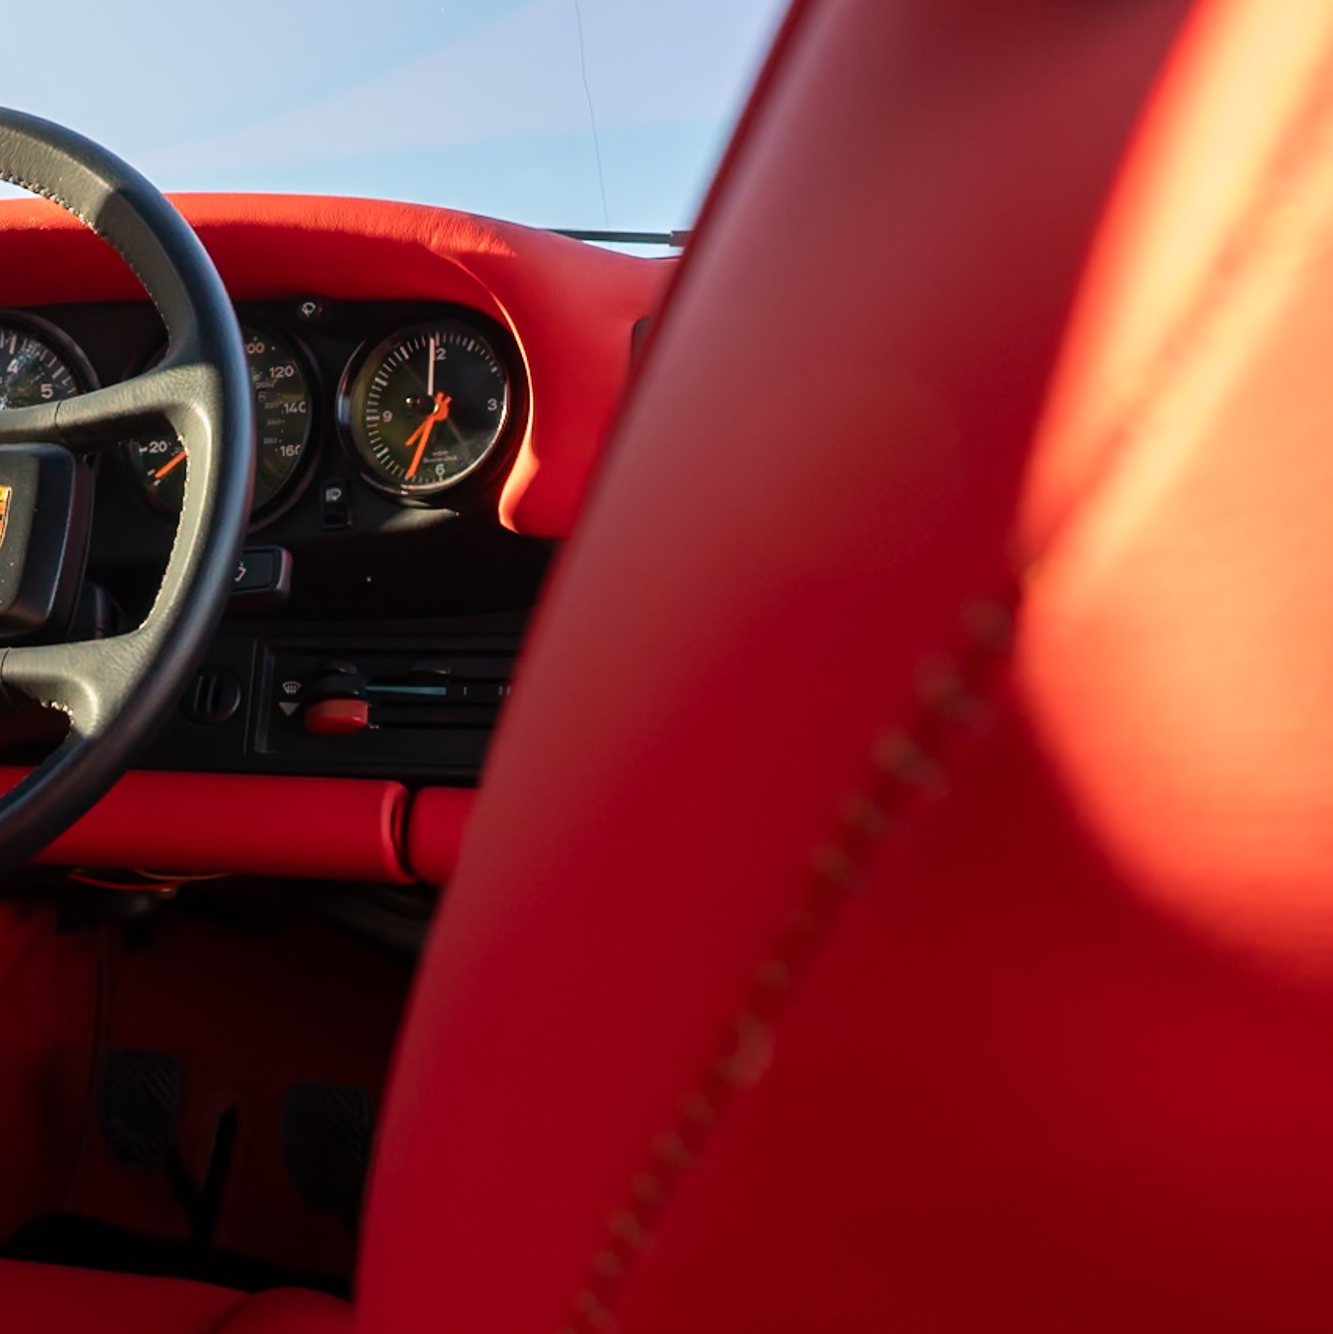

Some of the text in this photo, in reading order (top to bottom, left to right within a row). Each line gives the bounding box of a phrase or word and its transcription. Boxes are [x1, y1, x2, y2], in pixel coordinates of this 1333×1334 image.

[245, 342, 265, 354] 00
[435, 348, 446, 360] 2
[7, 359, 19, 374] 4
[268, 365, 295, 379] 120
[40, 383, 54, 399] 5
[283, 402, 306, 413] 140
[487, 398, 498, 411] 3
[382, 410, 393, 422] 9
[149, 441, 167, 453] 20
[435, 464, 445, 476] 6
